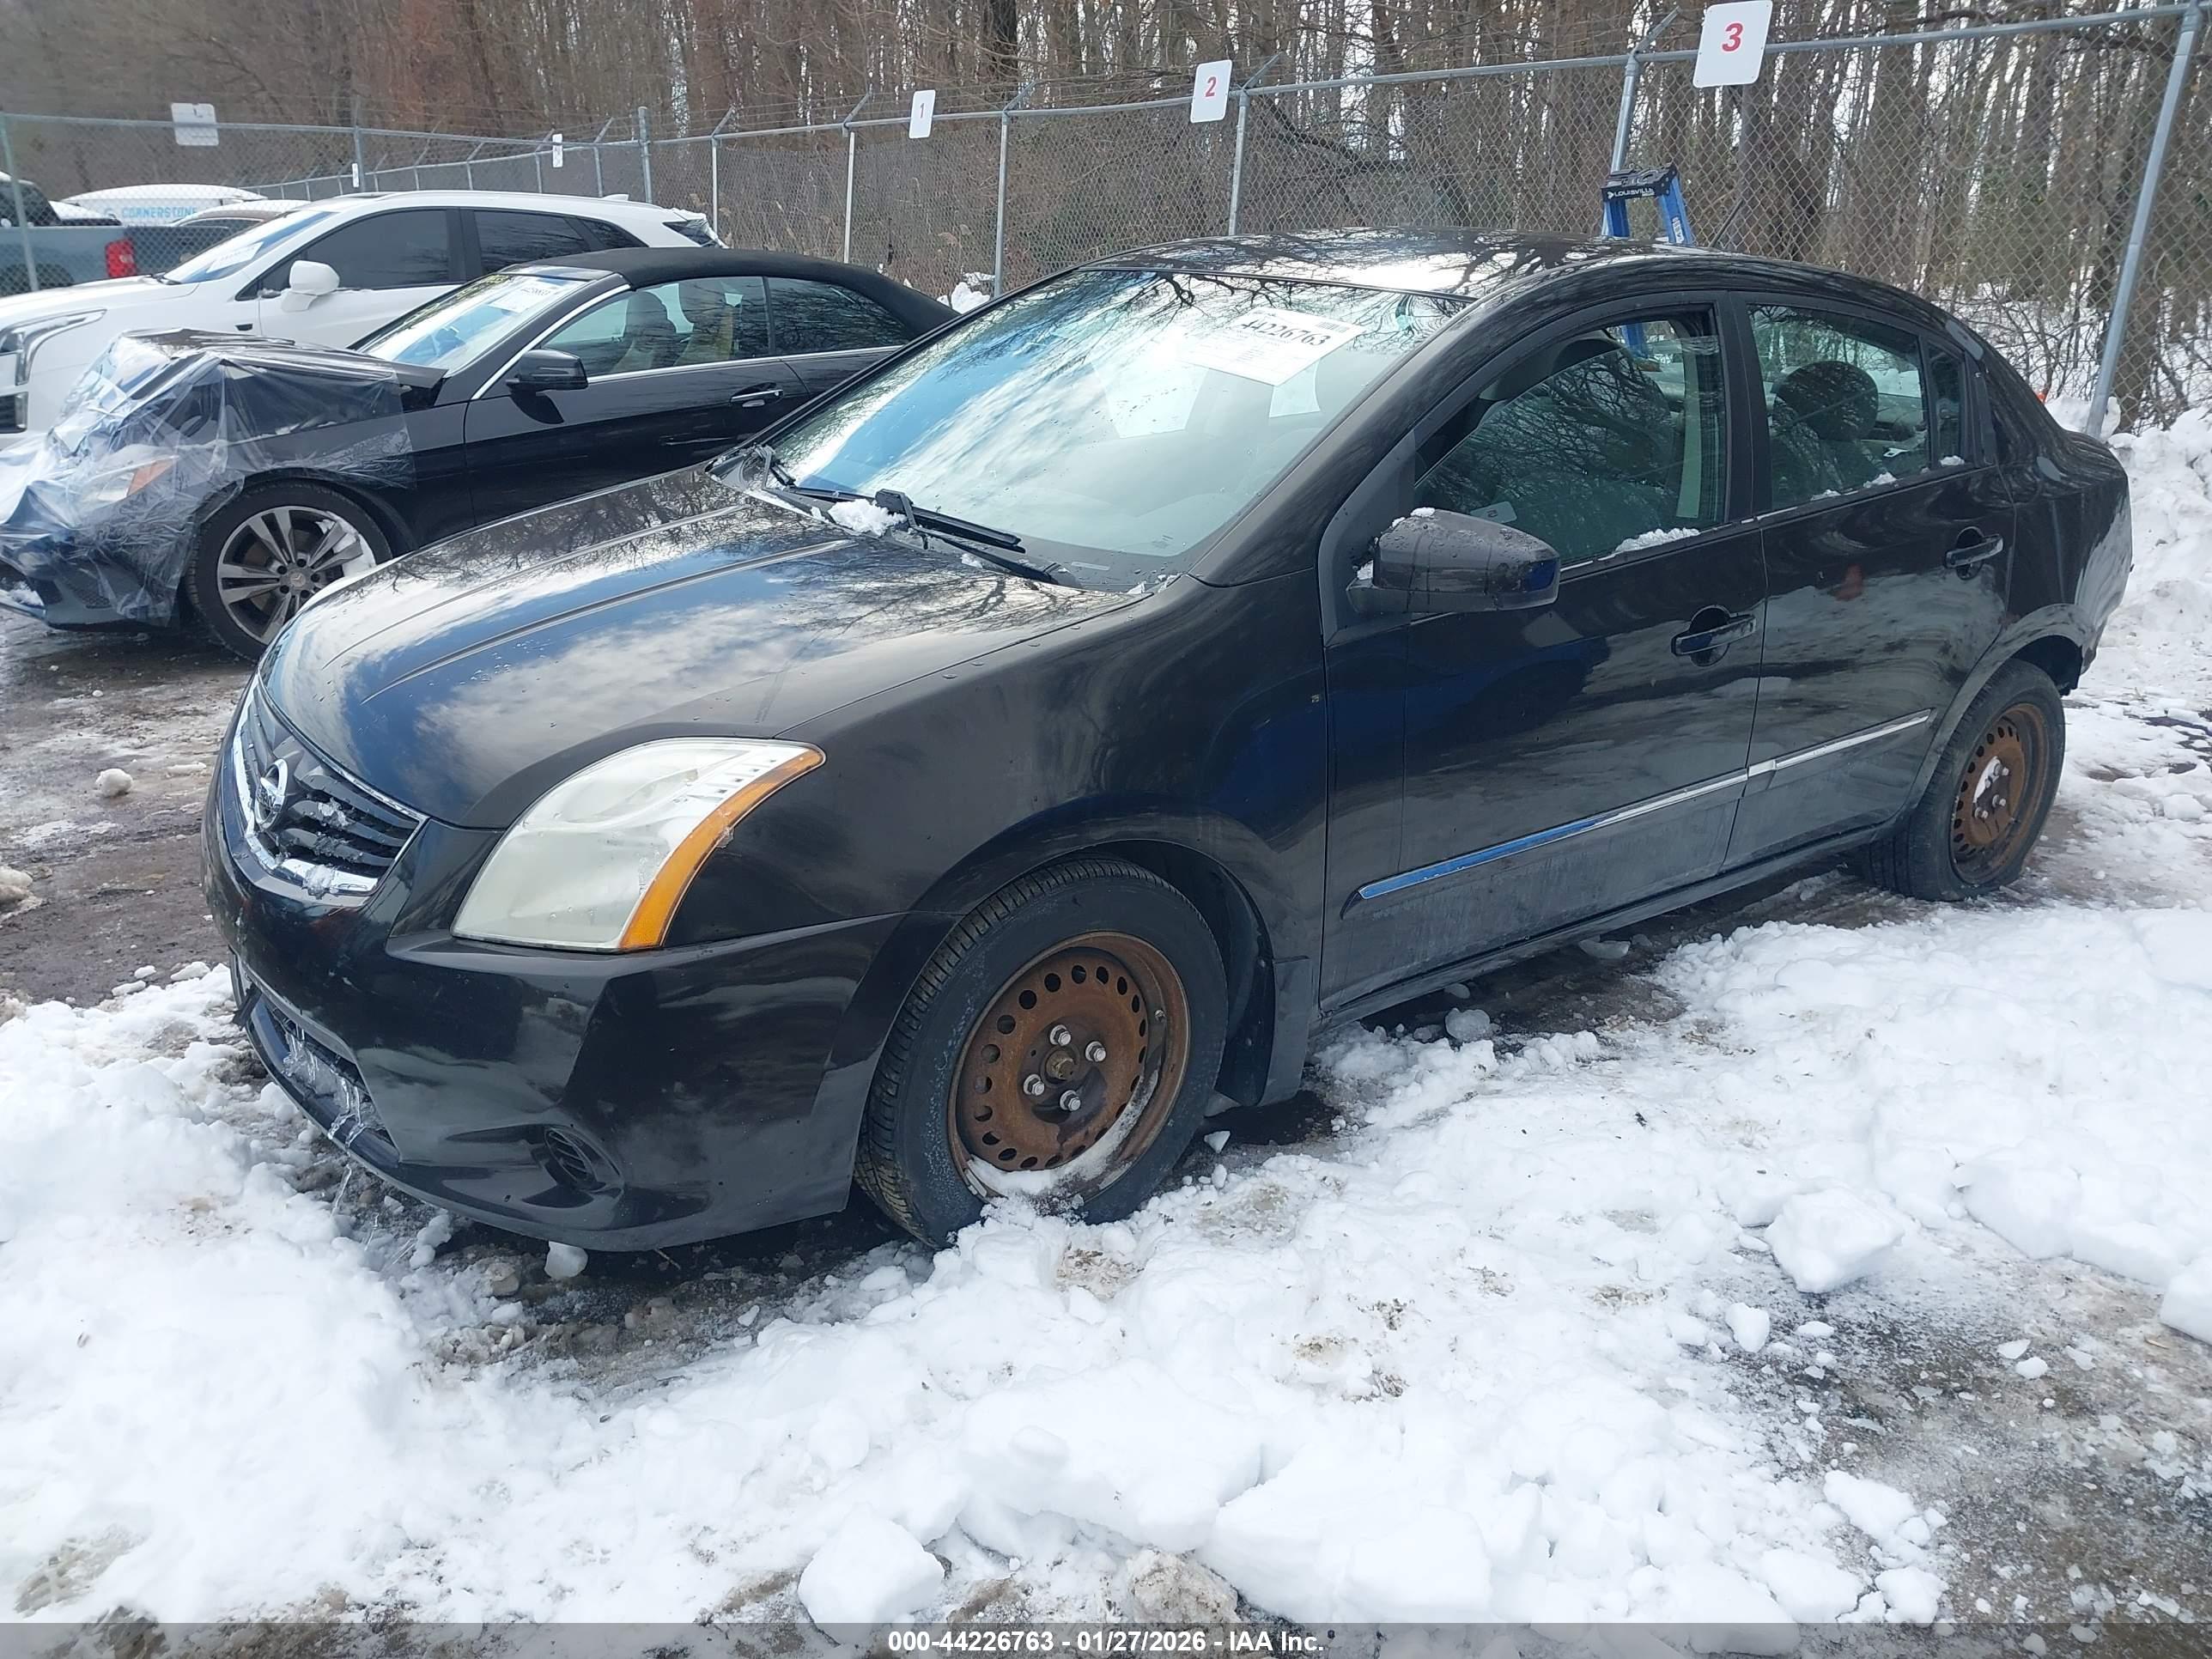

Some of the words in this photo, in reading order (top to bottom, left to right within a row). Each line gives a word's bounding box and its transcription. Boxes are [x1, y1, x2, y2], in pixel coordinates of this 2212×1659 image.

[1722, 22, 1743, 52] 3
[1205, 76, 1217, 97] 2
[920, 102, 925, 118] 1
[1614, 187, 1654, 197] LOUISVILLE
[123, 206, 198, 218] CORNERSTONE
[1241, 319, 1331, 346] 44226763
